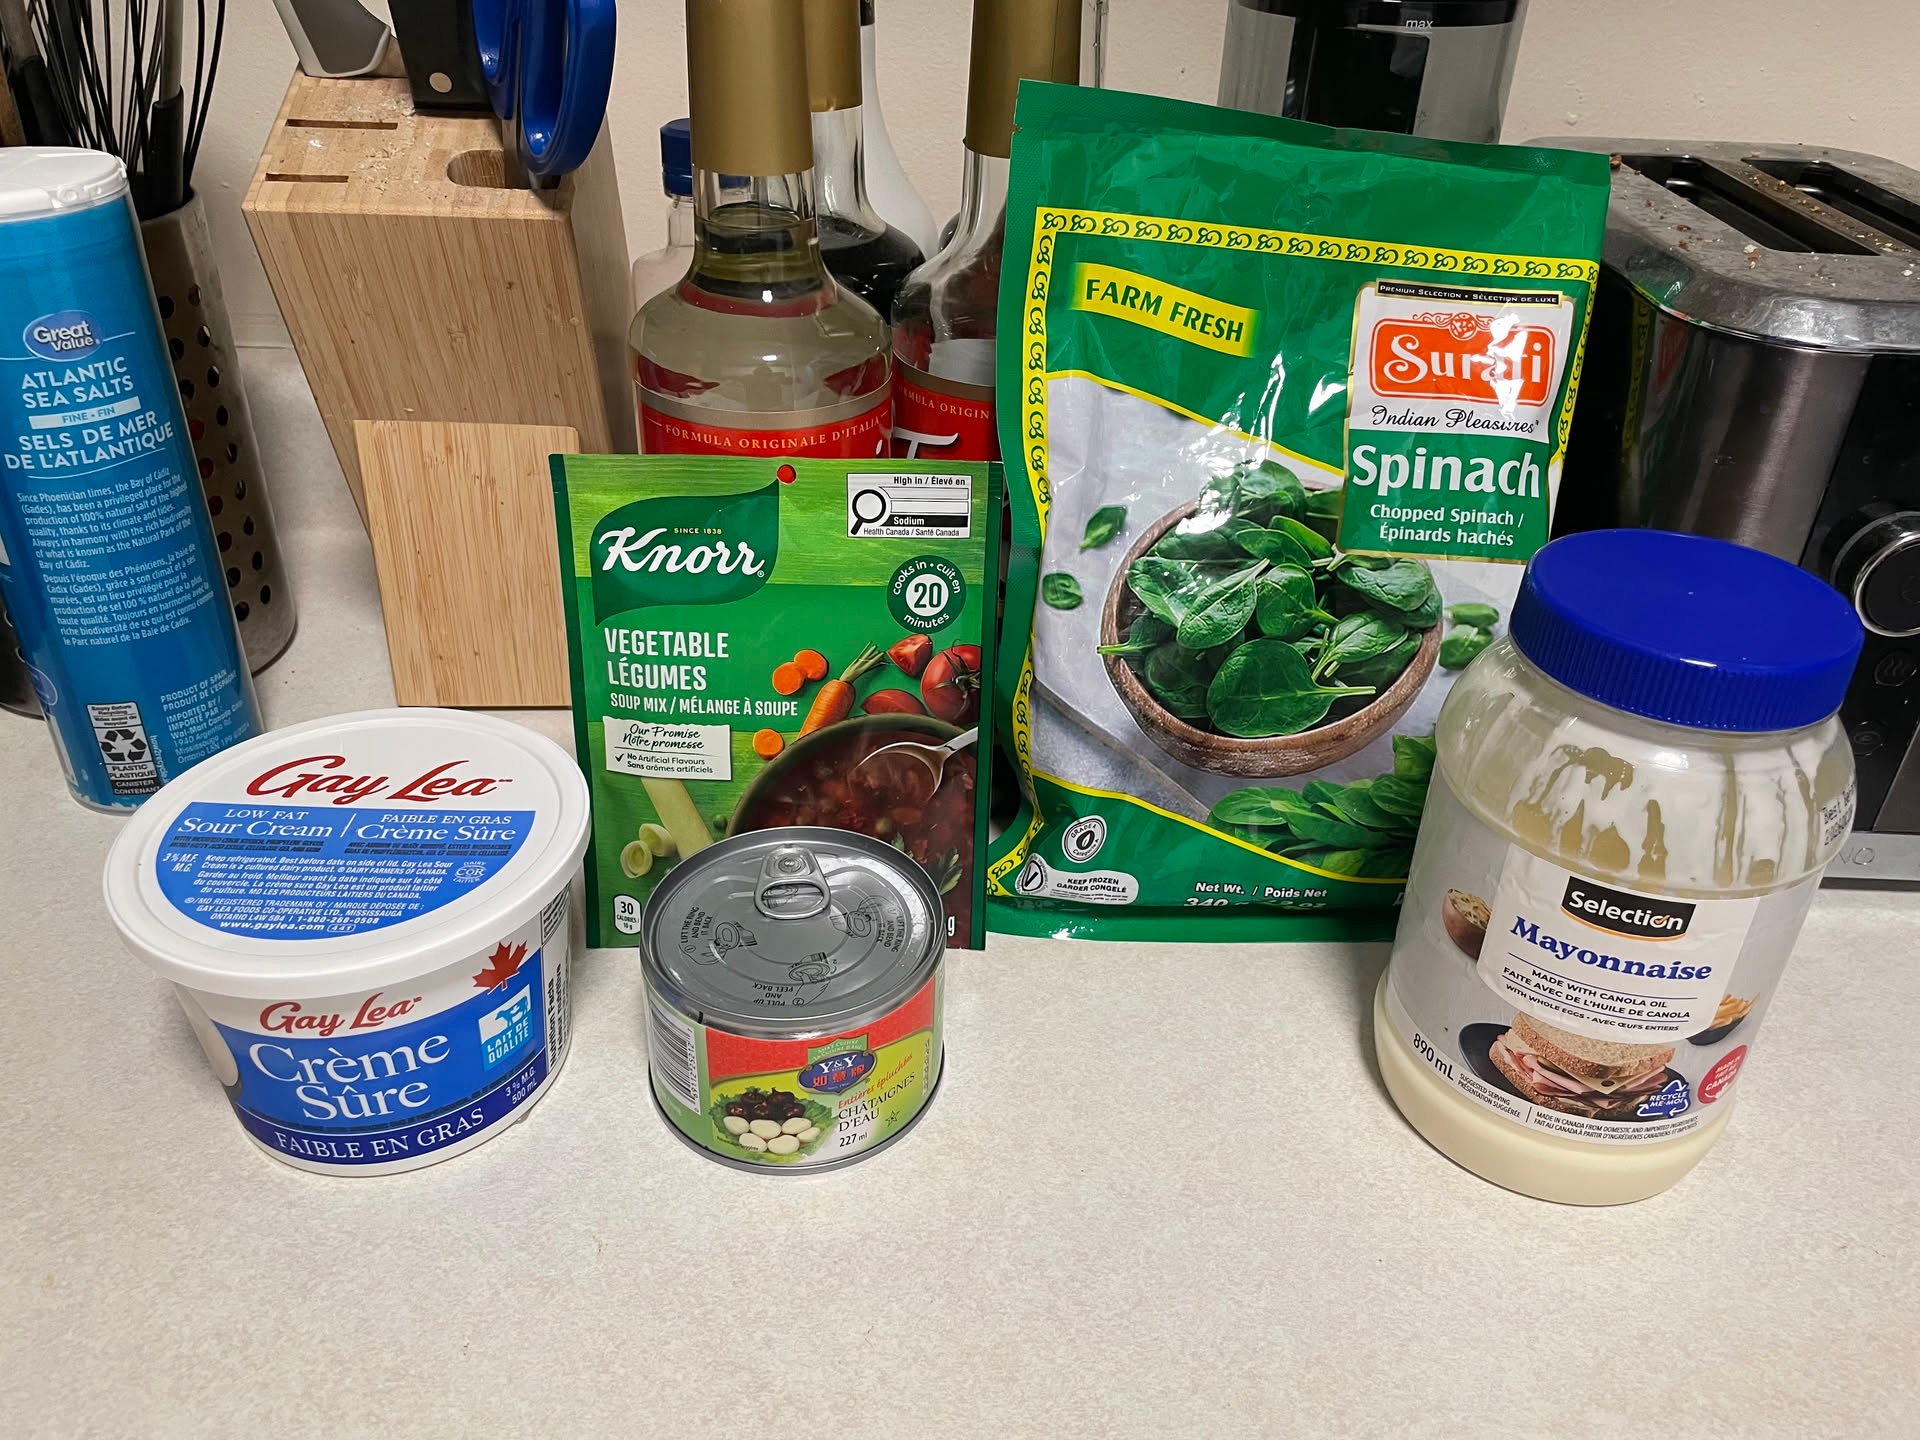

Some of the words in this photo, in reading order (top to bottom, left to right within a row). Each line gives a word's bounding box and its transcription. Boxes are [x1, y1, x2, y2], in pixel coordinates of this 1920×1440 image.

[1405, 18, 1434, 30] max
[1379, 284, 1416, 295] PREMIUM
[1417, 289, 1462, 299] SELECTION
[1534, 296, 1557, 304] LUXE
[1084, 277, 1162, 316] FARM
[1167, 298, 1245, 343] FRESH
[33, 320, 92, 343] Great
[50, 336, 94, 352] Value
[21, 356, 129, 390] ATLANTIC
[22, 389, 71, 409] SEA
[73, 374, 135, 403] SALTS
[62, 411, 89, 424] FINE
[98, 405, 116, 417] FIN
[1371, 404, 1441, 428] Indian
[1445, 408, 1536, 434] Pleasures
[18, 432, 75, 451] SELS
[82, 424, 114, 445] DE
[118, 410, 158, 438] MER
[665, 423, 733, 448] FORMULA
[738, 434, 827, 449] ORIGINALE
[831, 414, 881, 442] D'ITALIA
[4, 453, 36, 470] DE
[38, 420, 175, 469] L'ATLANTIQUE
[893, 476, 913, 485] High
[914, 476, 923, 485] in
[931, 475, 954, 486] Élevé
[955, 478, 966, 486] en
[1352, 444, 1541, 499] Spinach
[39, 491, 87, 503] Phoenician
[114, 482, 130, 493] the
[893, 516, 925, 526] Sodium
[1370, 503, 1445, 523] Chopped
[1450, 508, 1515, 526] Spinach
[863, 527, 885, 536] Health
[885, 527, 910, 537] Canada
[915, 527, 934, 537] Santé
[935, 528, 960, 537] Canada
[1379, 521, 1452, 543] Épinards
[1456, 527, 1515, 547] hachés
[598, 526, 766, 576] Knorr
[893, 564, 916, 595] cooks
[915, 560, 927, 571] in
[936, 561, 956, 580] cuit
[952, 580, 962, 594] en
[913, 582, 942, 609] 20
[903, 612, 950, 629] minutes
[604, 627, 729, 659] VEGETABLE
[607, 659, 708, 692] LÉGUMES
[160, 684, 199, 703] PRODUCT
[610, 692, 641, 710] SOUP
[643, 696, 666, 713] MIX
[679, 696, 741, 715] MÉLANGE
[743, 696, 752, 716] À
[755, 700, 799, 717] SOUPE
[622, 733, 651, 747] Notre
[650, 737, 705, 751] promesse
[629, 723, 651, 735] Our
[651, 726, 701, 739] Promise
[111, 763, 149, 773] PLASTIC
[627, 752, 638, 761] No
[638, 753, 671, 764] Artificial
[671, 757, 706, 766] Flavours
[627, 760, 645, 770] Sans
[645, 763, 675, 773] arômes
[676, 764, 714, 774] artificiels
[246, 754, 390, 805] Gay
[397, 759, 502, 804] Lea
[223, 808, 271, 819] LOW
[271, 810, 310, 820] FAT
[380, 814, 438, 825] FAIBLE
[441, 814, 466, 825] EN
[468, 815, 513, 825] GRAS
[177, 817, 244, 835] Sour
[246, 820, 333, 838] Cream
[356, 823, 450, 841] Crème
[453, 824, 518, 841] Sûre
[205, 854, 226, 863] Keep
[456, 867, 485, 877] COR
[1088, 877, 1120, 886] FROZEN
[1056, 882, 1089, 892] GARDER
[1089, 884, 1127, 893] CONGELÉ
[1194, 881, 1221, 893] Net
[1222, 883, 1246, 895] Wt.
[1263, 886, 1301, 899] Poids
[1303, 888, 1328, 898] Net
[620, 901, 634, 915] 30
[1568, 890, 1684, 931] Selection
[219, 920, 325, 931] www.gaylea.com
[1509, 915, 1713, 981] Mayonnaise
[1503, 966, 1533, 986] FAITE
[1532, 981, 1564, 998] AVEC
[1565, 993, 1581, 1004] DE
[1582, 998, 1626, 1015] L'HUILE
[1627, 1007, 1644, 1017] DE
[1646, 1009, 1692, 1019] CANOLA
[1531, 969, 1564, 988] MADE
[1566, 981, 1598, 998] WITH
[1599, 992, 1647, 1008] CANOLA
[1649, 1000, 1668, 1009] OIL
[259, 1001, 346, 1037] Gay
[349, 992, 415, 1030] Lea
[1505, 983, 1528, 999] WITH
[1528, 994, 1561, 1011] WHOLE
[1561, 1007, 1586, 1019] EGGS
[1591, 1016, 1616, 1027] AVEC
[1644, 1024, 1681, 1032] ENTIERS
[487, 1029, 514, 1053] LAIT
[515, 1016, 530, 1033] DE
[248, 1034, 451, 1087] Crème
[818, 1053, 858, 1075] Y&Y
[1413, 1032, 1435, 1063] 890
[1435, 1057, 1455, 1081] mL
[295, 1080, 432, 1121] Sûre
[511, 1087, 527, 1105] 500
[526, 1078, 538, 1094] mL
[838, 1071, 916, 1121] CHÂTAIGNES
[838, 1083, 876, 1110] Entières
[1459, 1072, 1488, 1095] SUGGESTED
[1487, 1089, 1511, 1106] SERVING
[1649, 1091, 1688, 1101] RECYCLE
[839, 1107, 881, 1133] D'EAU
[274, 1130, 365, 1159] FAIBLE
[372, 1135, 410, 1158] EN
[416, 1107, 486, 1149] GRAS
[839, 1133, 858, 1148] 227
[858, 1131, 869, 1141] ml
